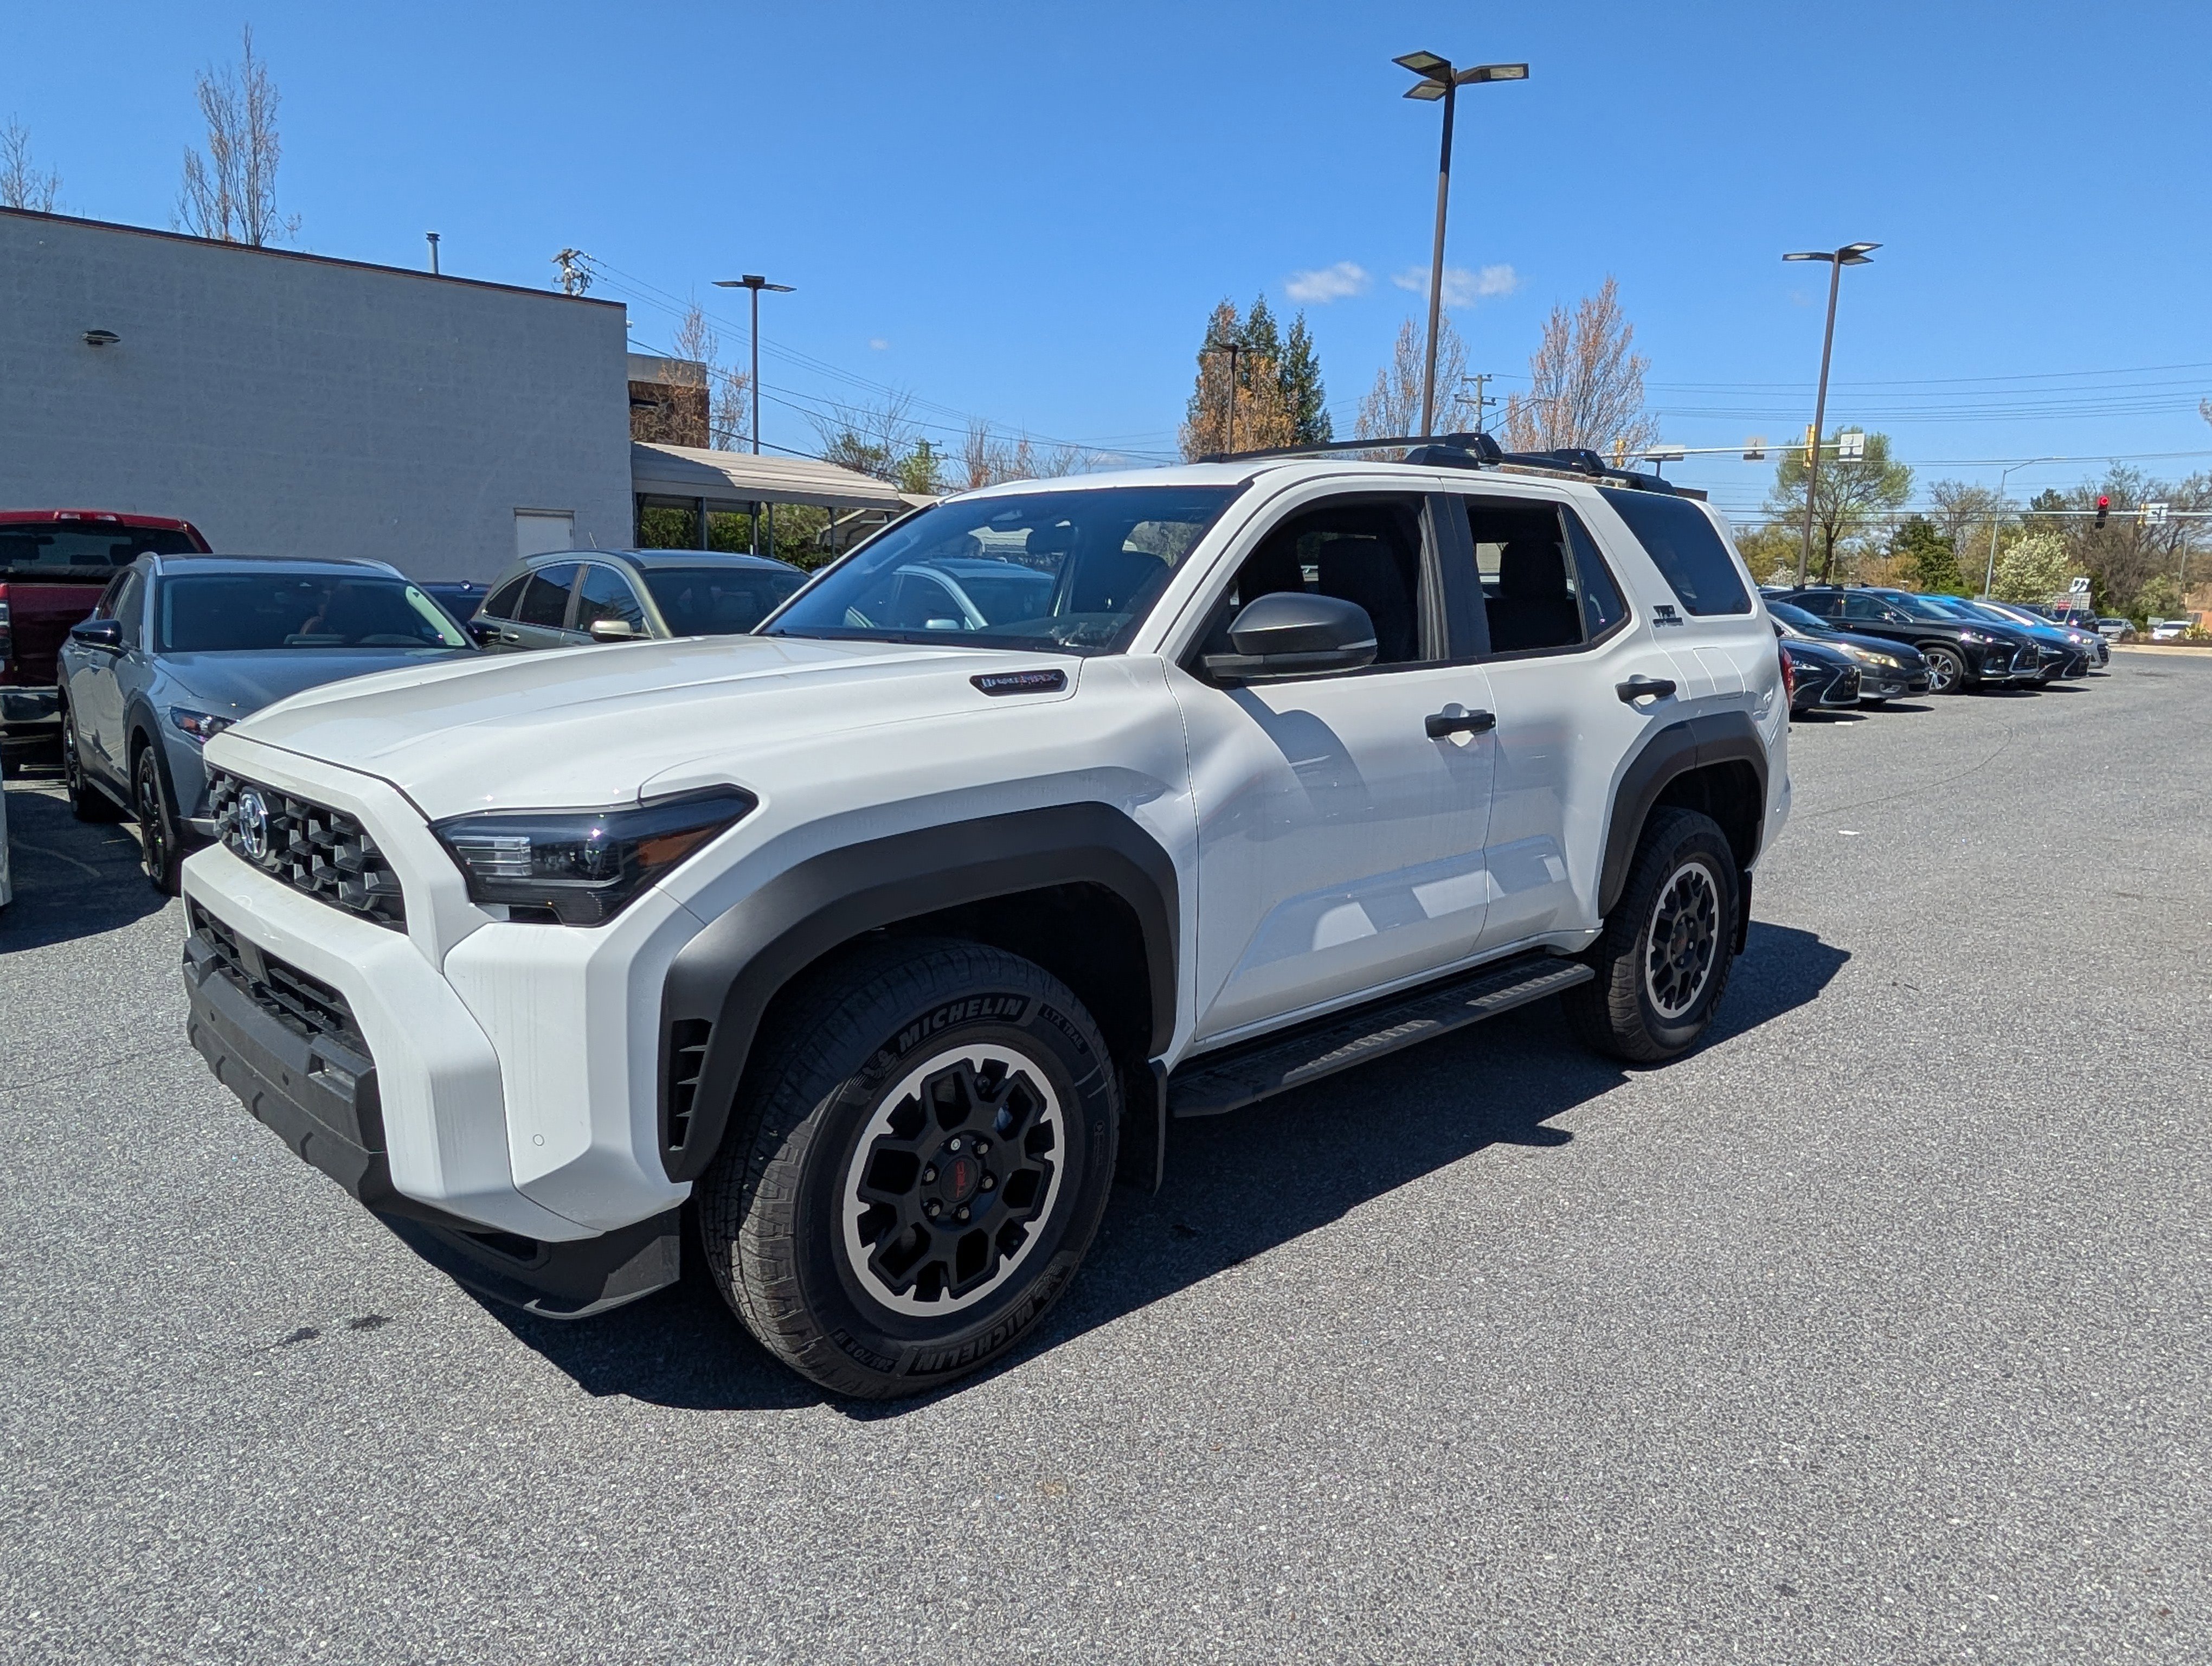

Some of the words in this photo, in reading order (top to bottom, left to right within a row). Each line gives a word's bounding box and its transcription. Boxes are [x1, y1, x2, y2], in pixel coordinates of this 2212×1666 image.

[898, 997, 1024, 1053] MICHELIN
[1043, 1007, 1064, 1027] LTX
[1063, 1022, 1084, 1050] TRAIL
[915, 1300, 1034, 1372] MICHELIN
